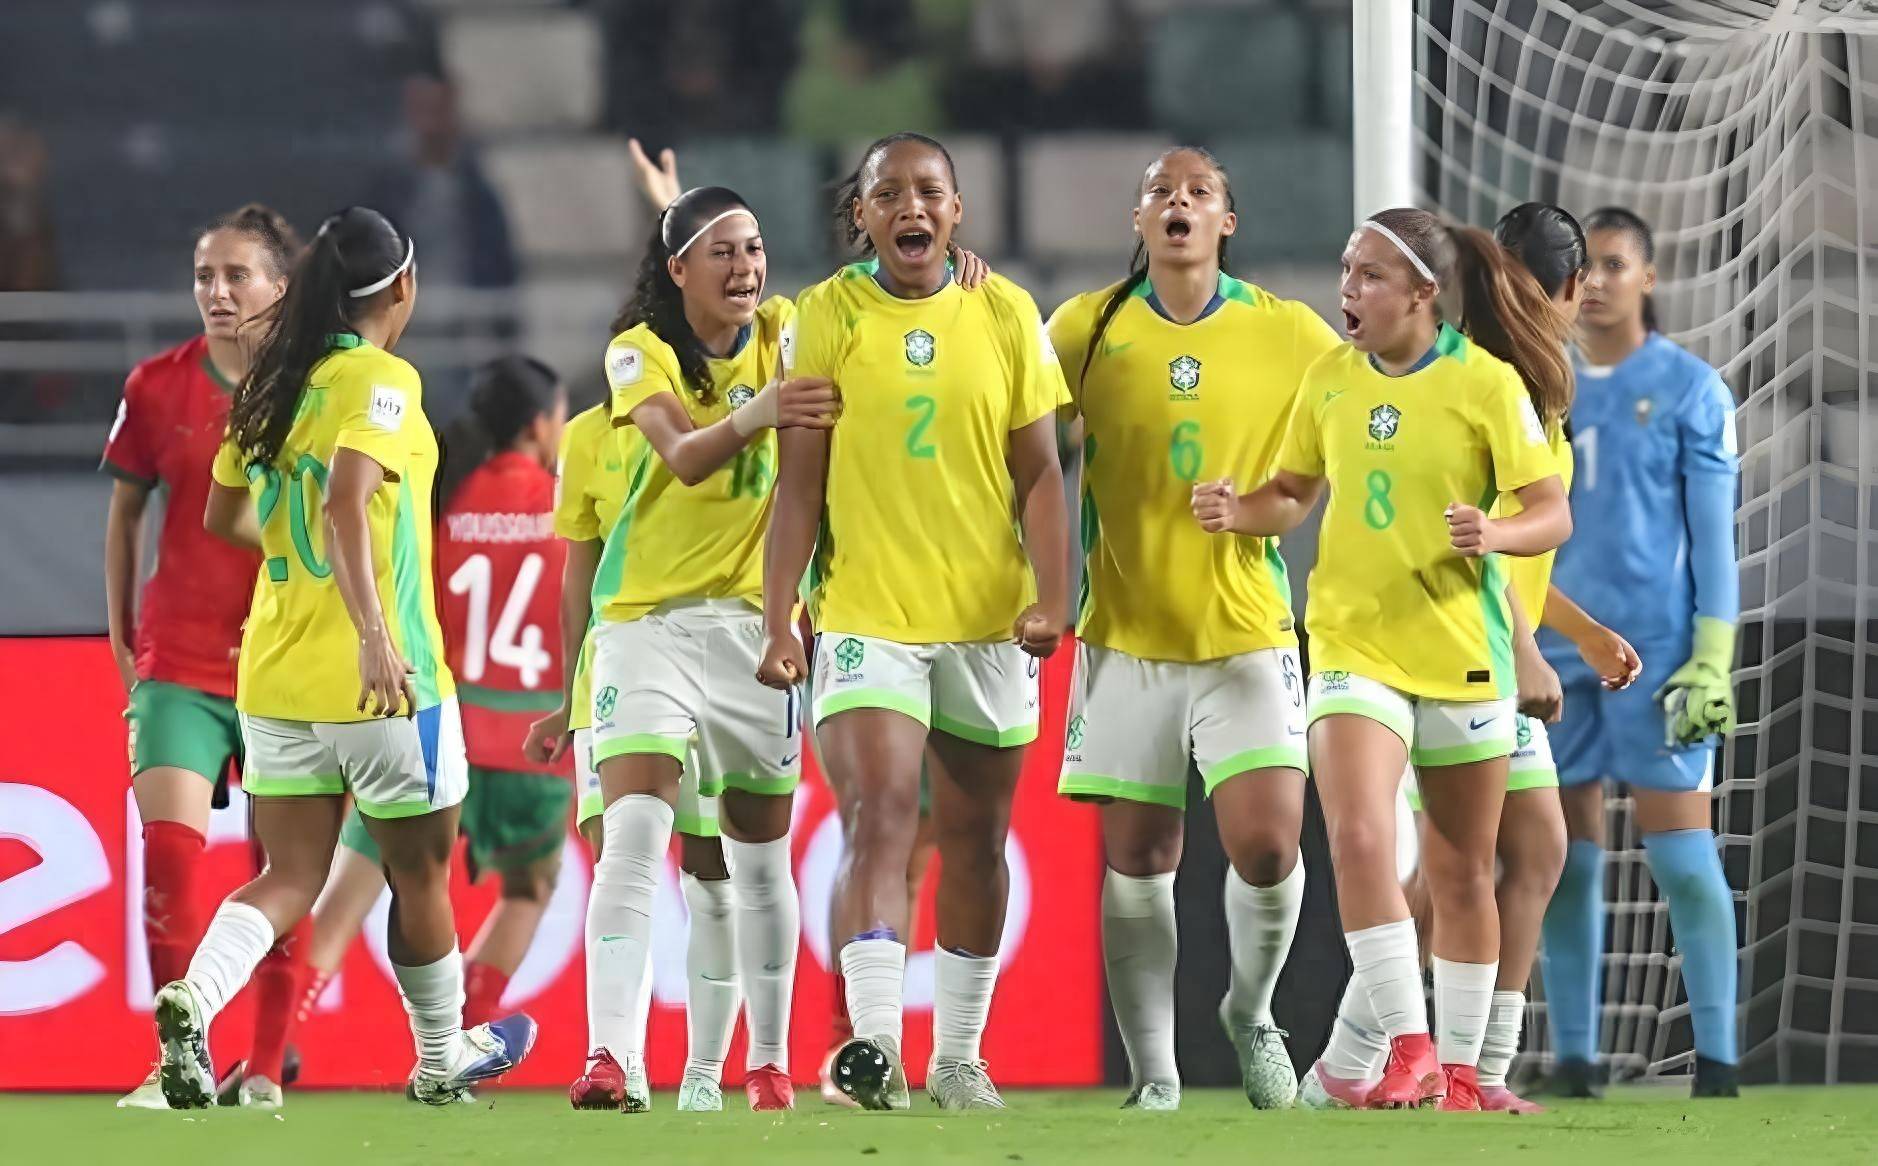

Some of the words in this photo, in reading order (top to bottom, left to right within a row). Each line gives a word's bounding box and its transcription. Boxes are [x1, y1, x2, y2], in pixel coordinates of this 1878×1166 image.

[905, 395, 936, 458] 2
[1170, 420, 1203, 482] 6
[1573, 426, 1598, 491] 1
[245, 453, 333, 583] 20
[1364, 469, 1395, 530] 8
[448, 553, 552, 689] 14
